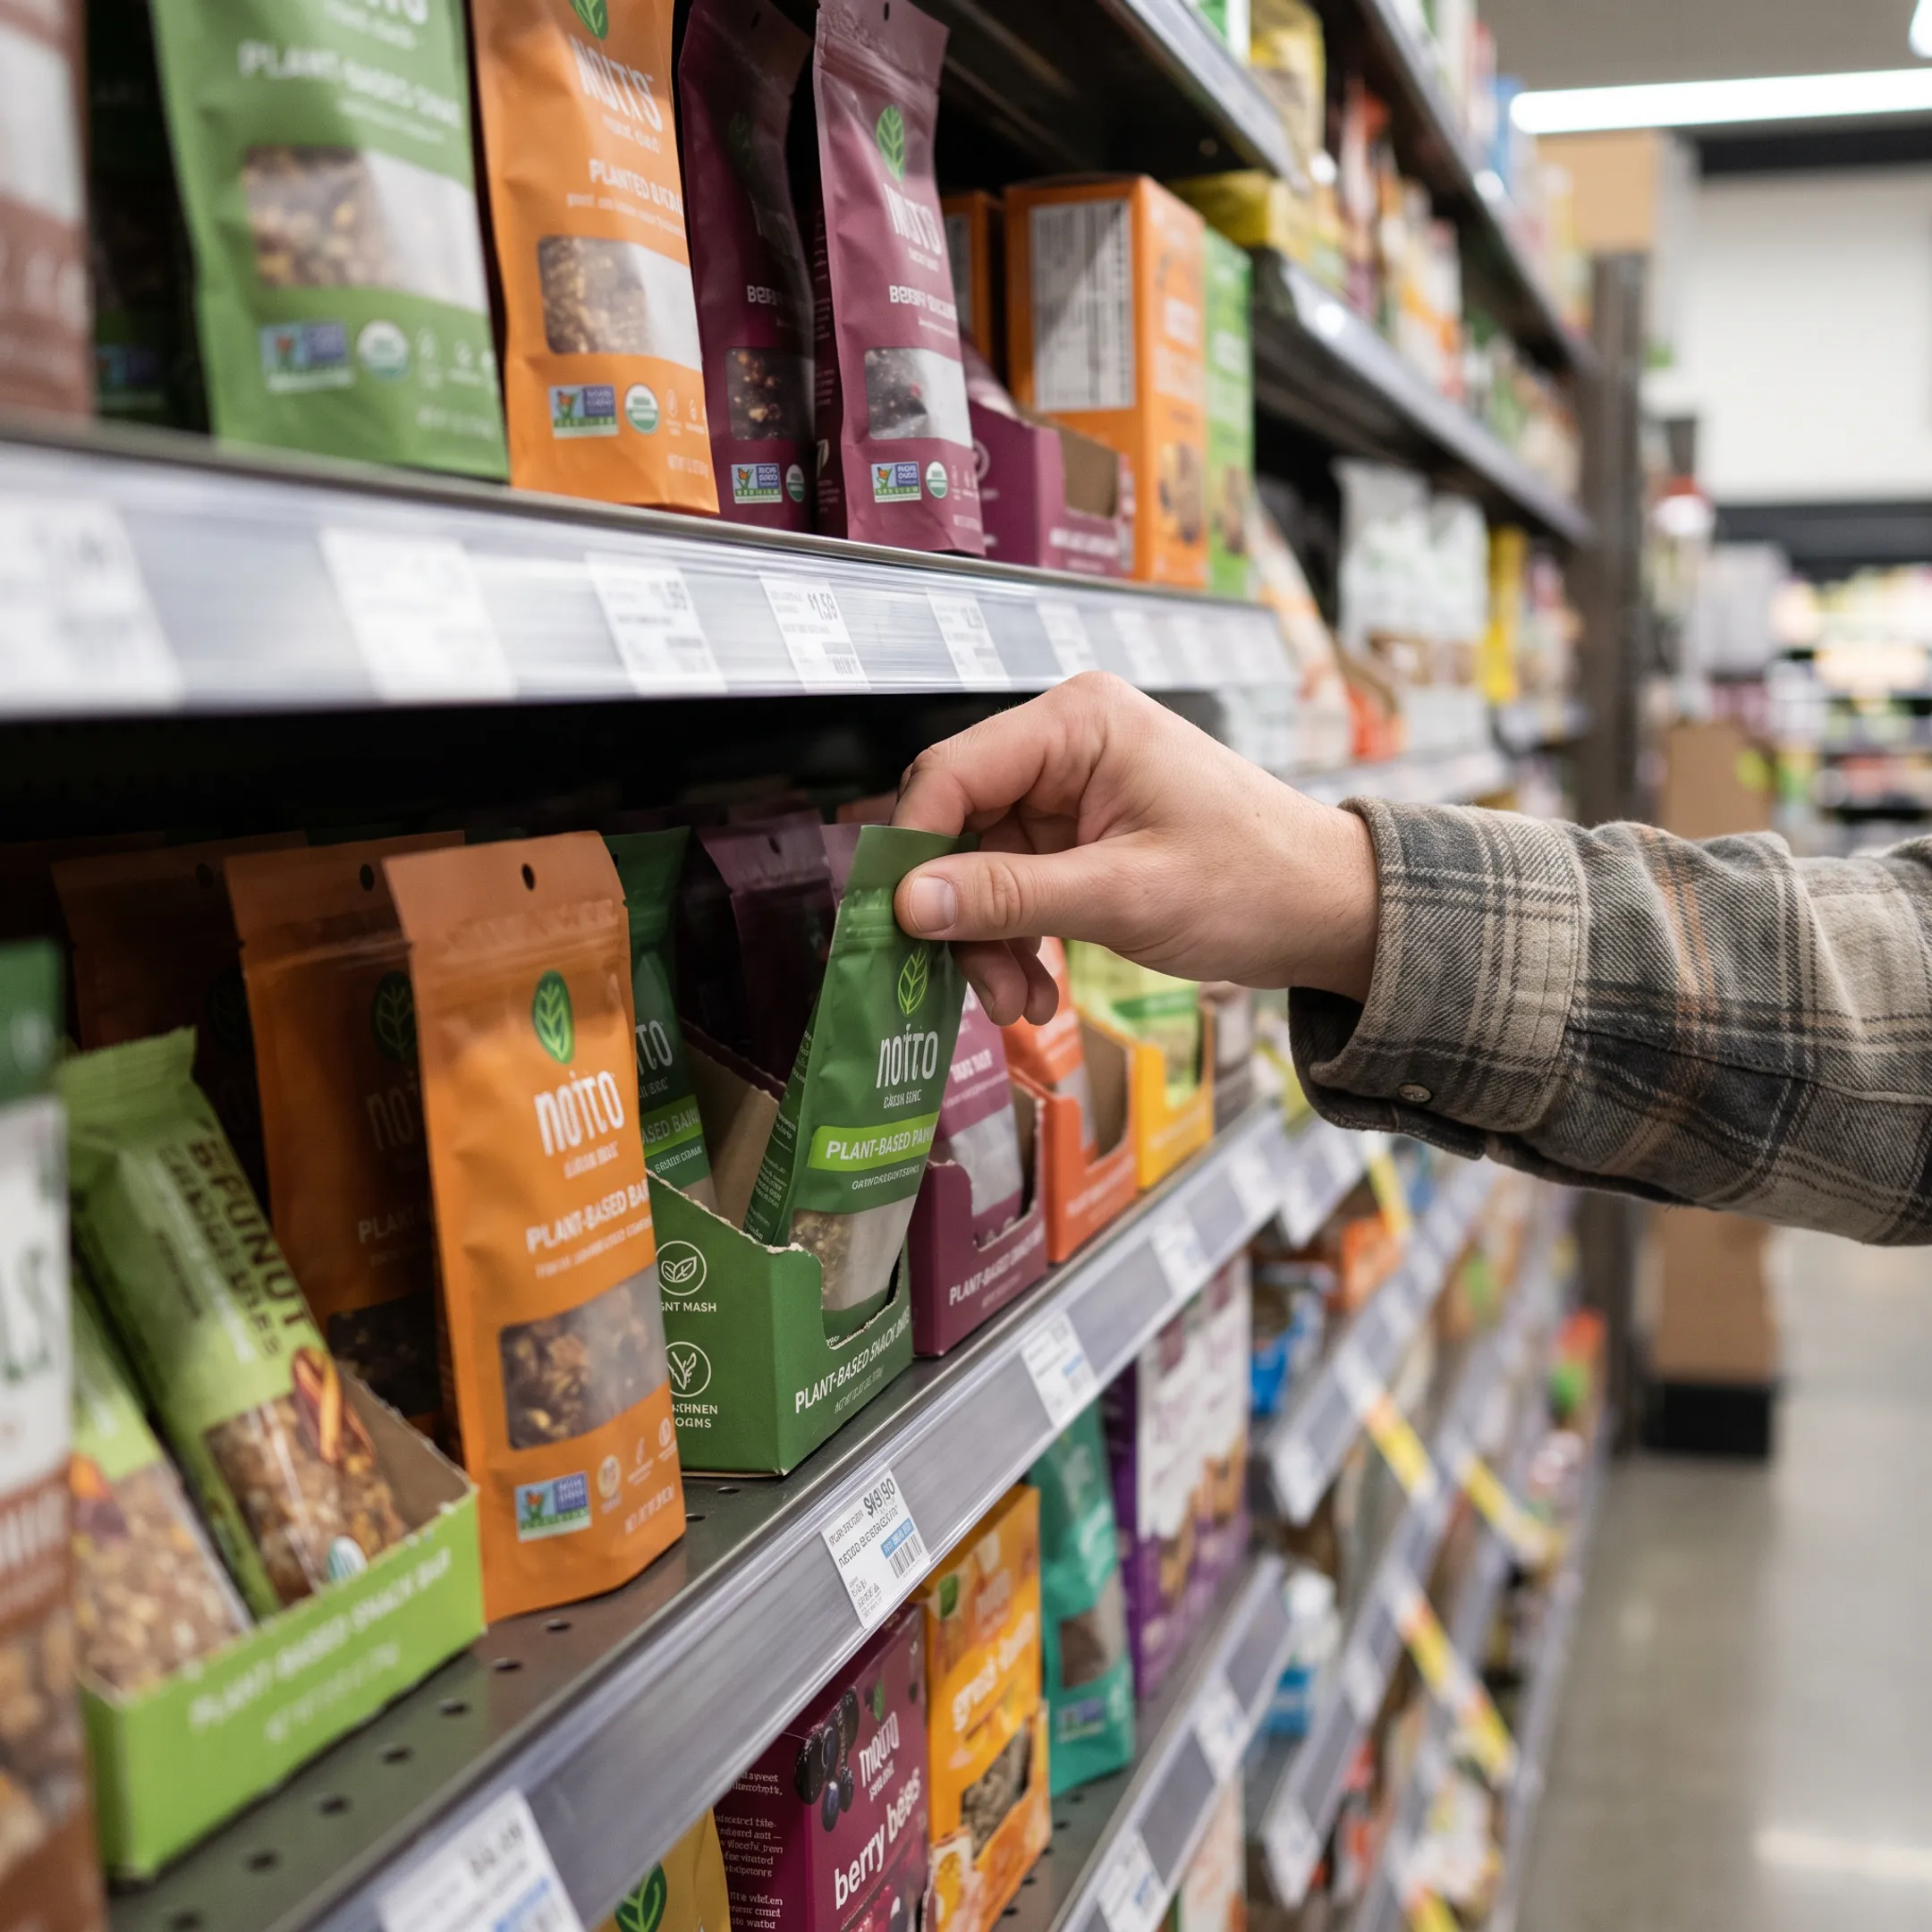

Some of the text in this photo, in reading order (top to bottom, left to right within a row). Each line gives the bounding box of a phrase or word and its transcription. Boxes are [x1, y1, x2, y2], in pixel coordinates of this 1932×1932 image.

[826, 1131, 911, 1161] PLANT-BASED
[683, 1301, 717, 1312] MASH
[795, 1348, 869, 1414] PLANT-BASED
[835, 1823, 886, 1910] berry
